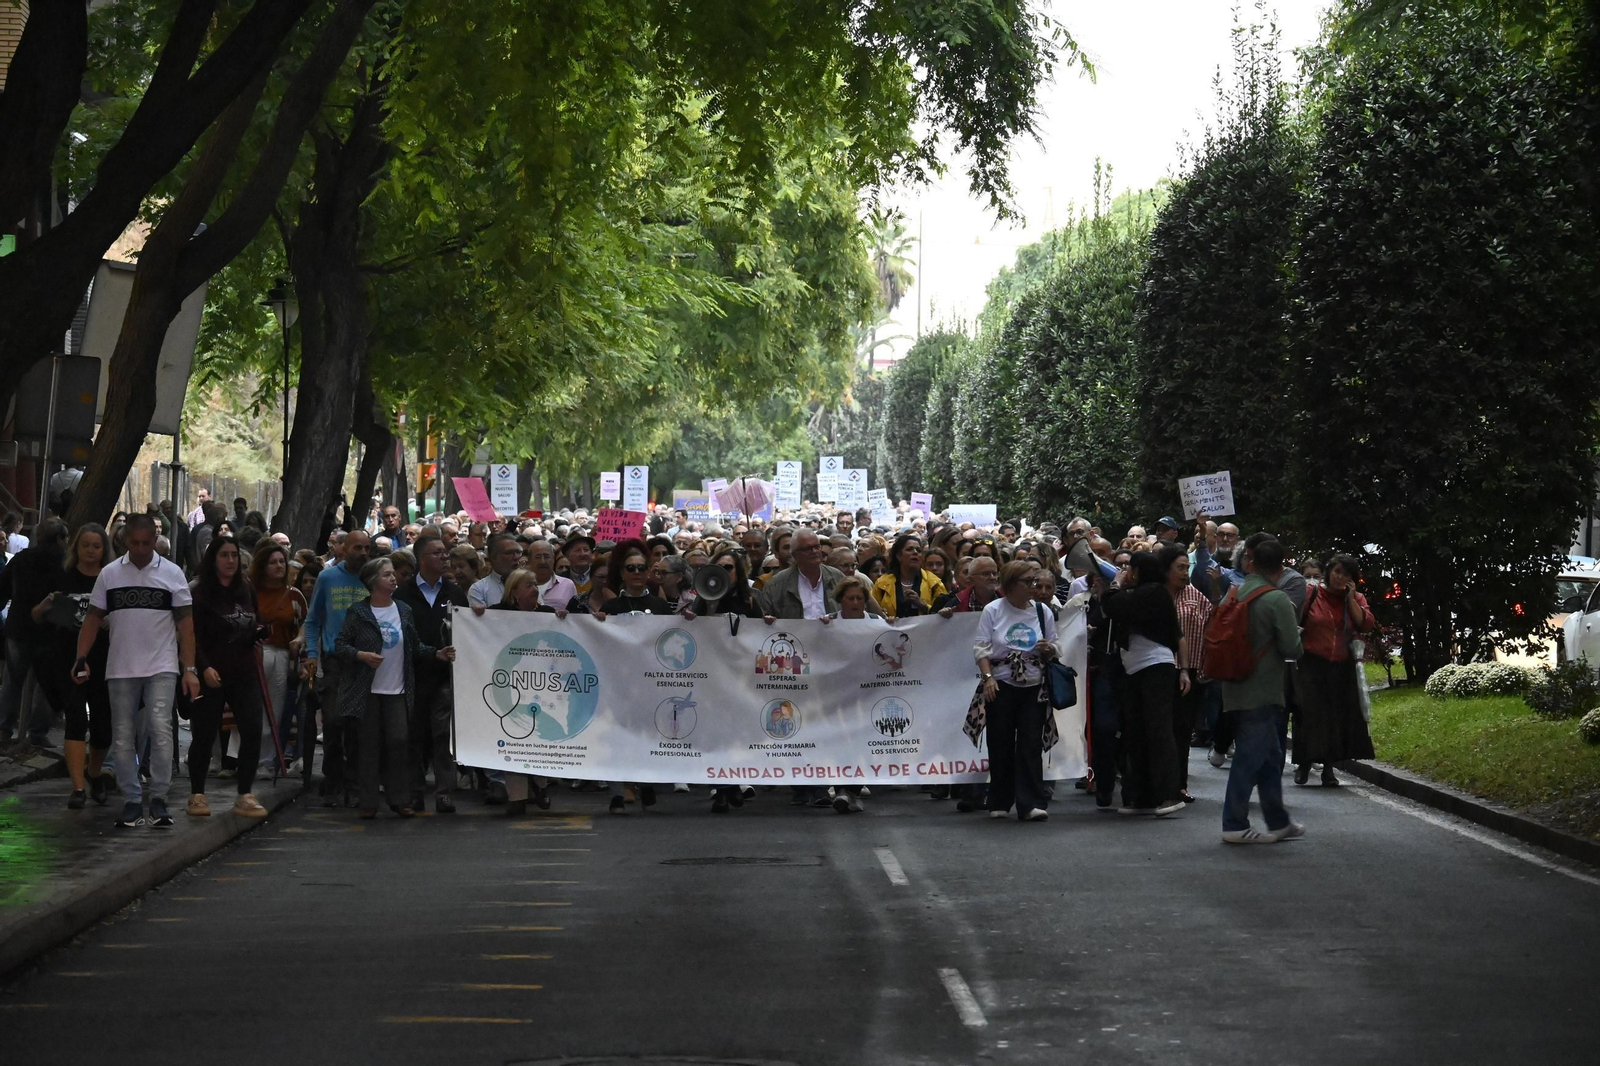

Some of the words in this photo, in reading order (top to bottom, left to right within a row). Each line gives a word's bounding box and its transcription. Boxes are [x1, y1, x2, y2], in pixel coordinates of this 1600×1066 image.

[1183, 487, 1224, 498] PERJUDICA
[114, 590, 164, 607] BOSS
[492, 669, 598, 693] ONUSAP
[860, 680, 922, 688] MATERNO-INFANTIL
[707, 767, 785, 778] SANIDAD
[792, 764, 865, 778] PÚBLICA
[870, 765, 882, 777] Y
[889, 764, 910, 776] DE
[916, 759, 990, 775] CALIDAD
